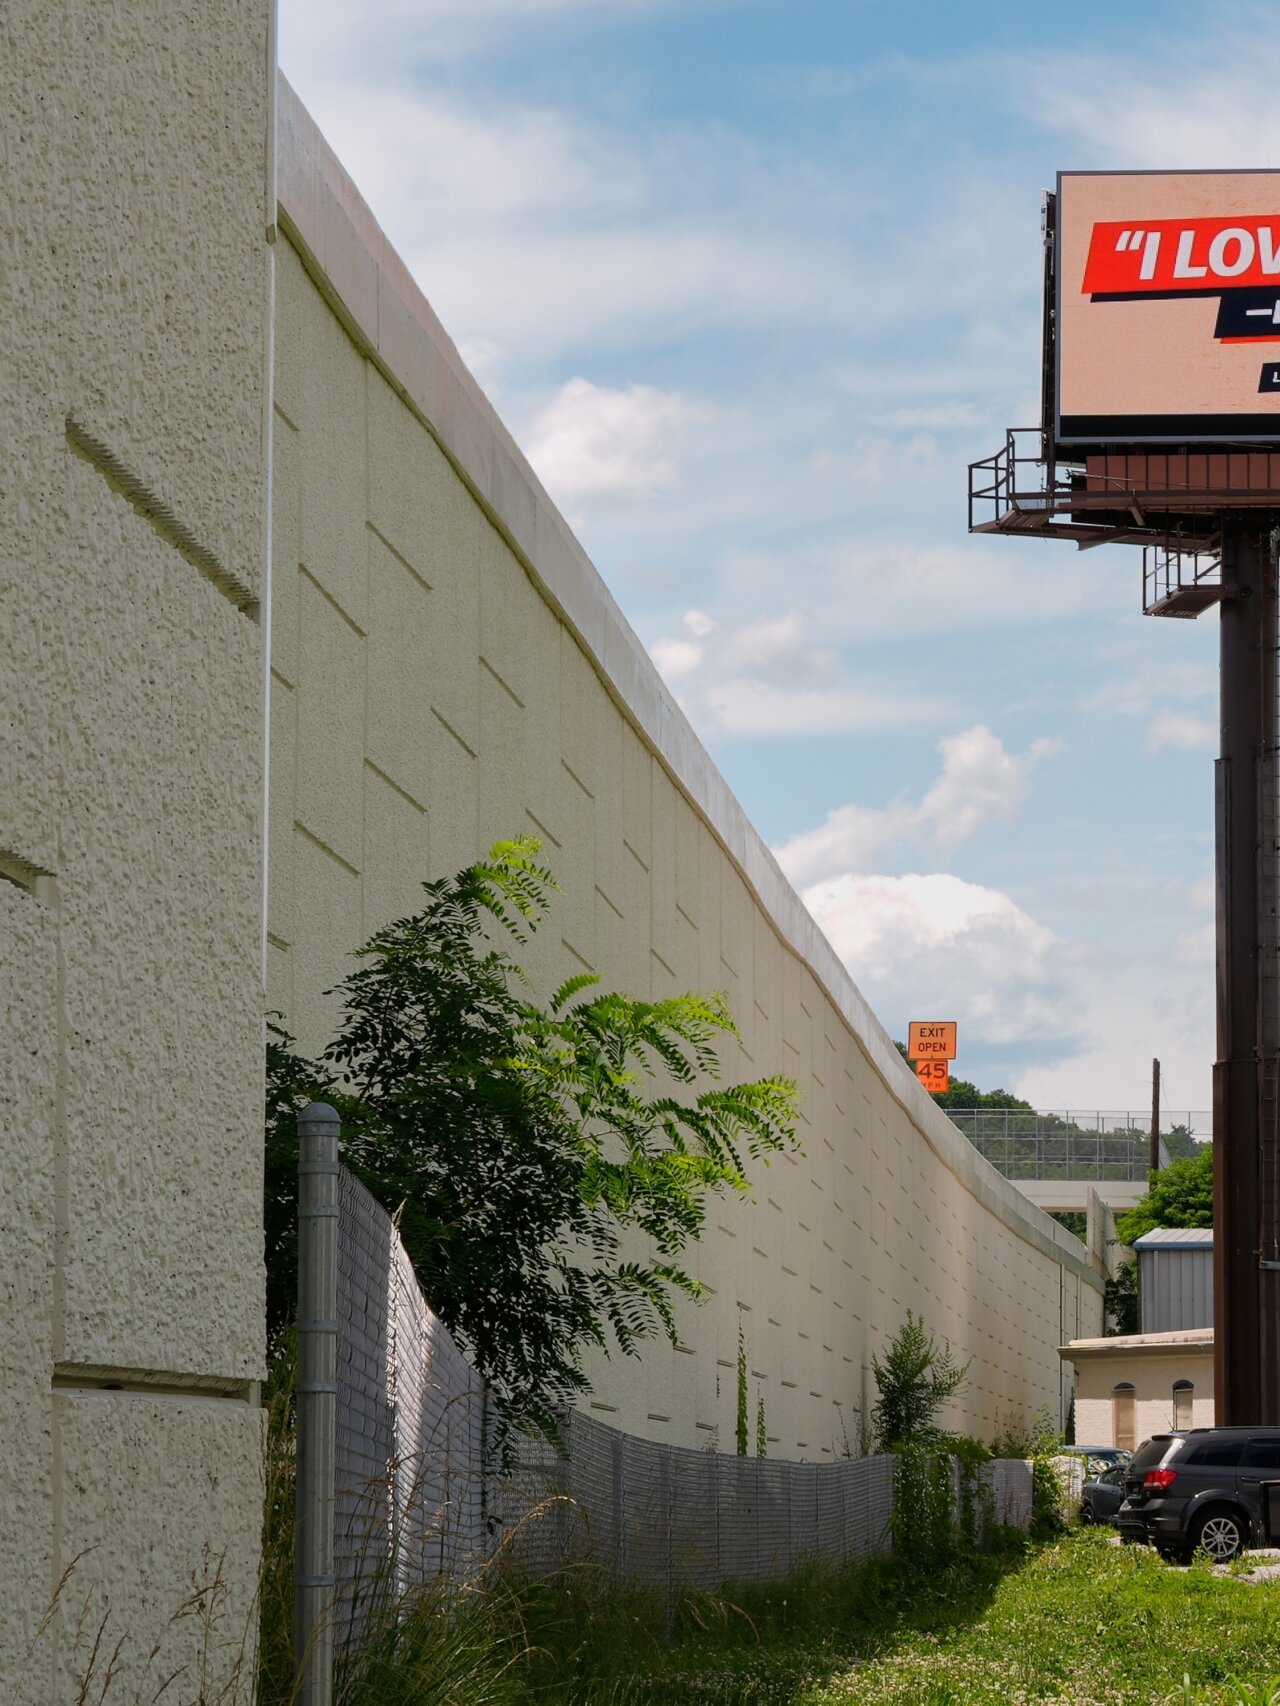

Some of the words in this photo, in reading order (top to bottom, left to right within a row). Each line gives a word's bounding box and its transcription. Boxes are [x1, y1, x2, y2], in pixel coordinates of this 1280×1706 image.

[920, 1028, 946, 1037] EXIT
[918, 1042, 946, 1052] OPEN
[918, 1063, 945, 1079] 45
